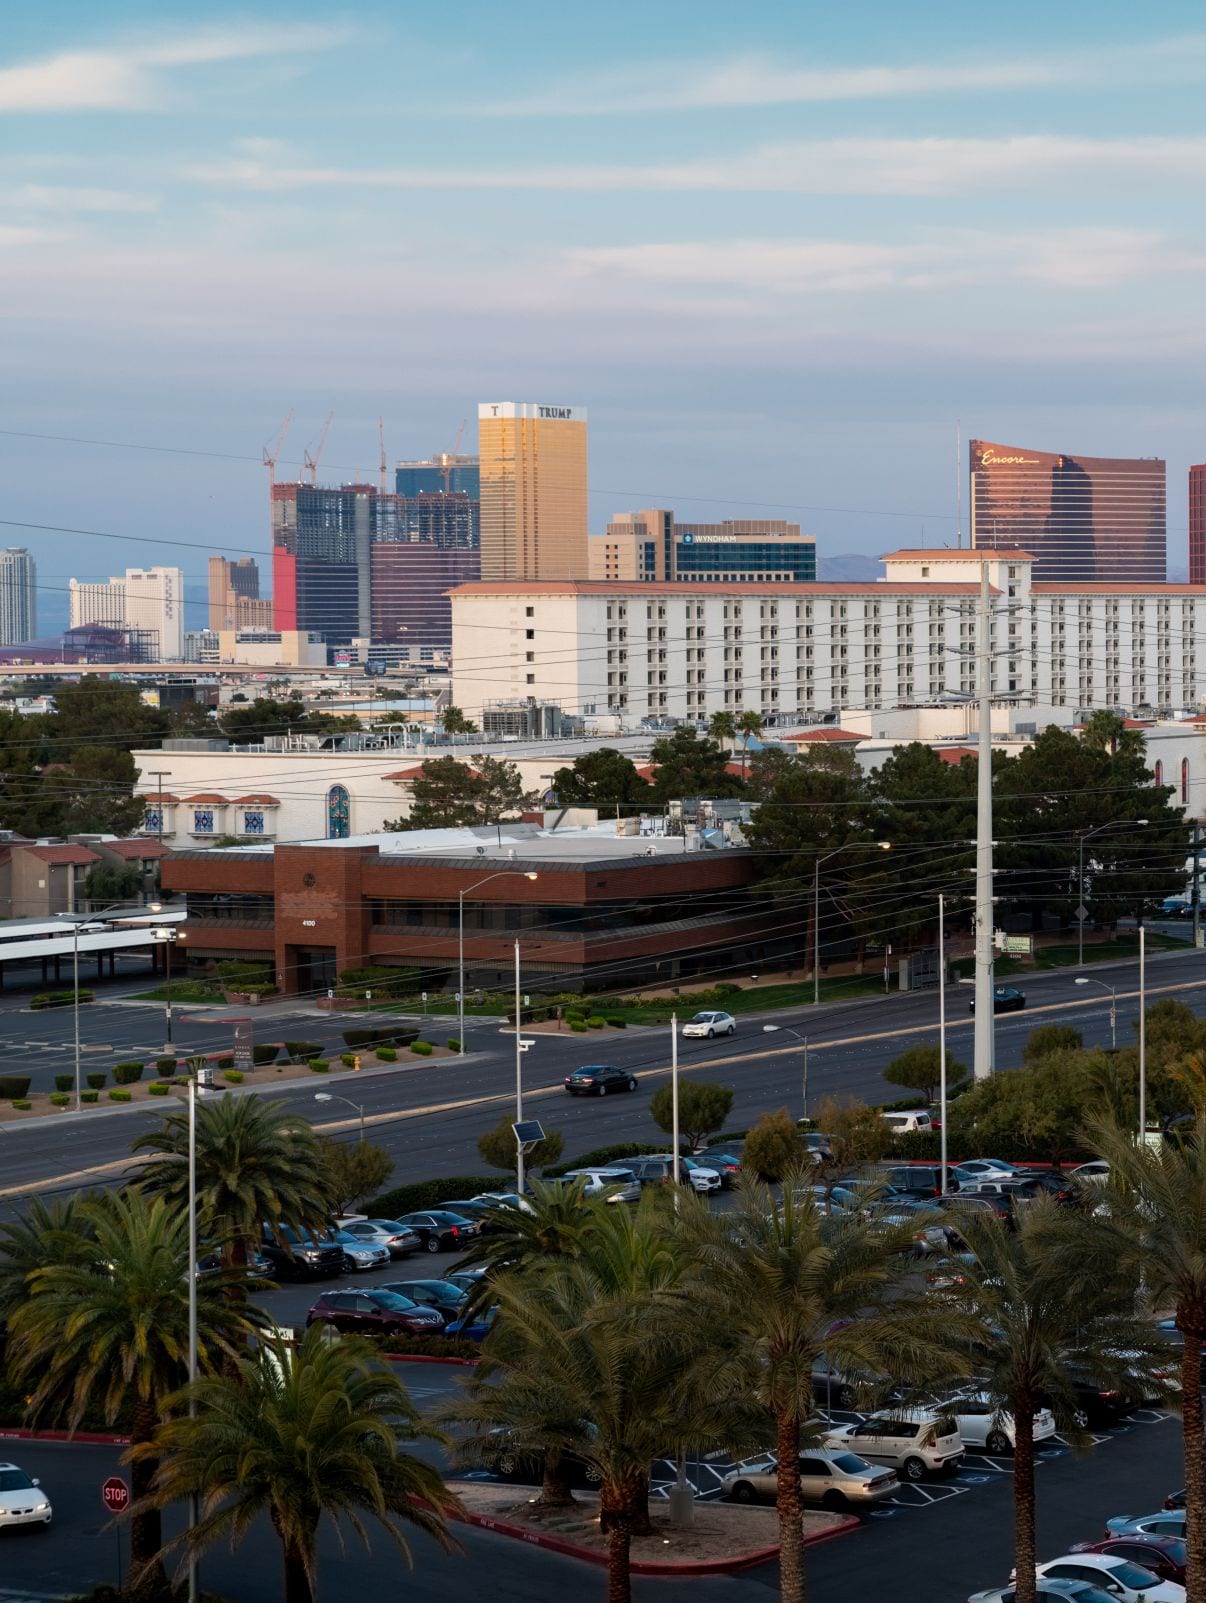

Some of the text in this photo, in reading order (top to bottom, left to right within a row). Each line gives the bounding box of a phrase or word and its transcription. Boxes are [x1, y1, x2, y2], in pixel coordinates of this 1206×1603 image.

[491, 406, 499, 417] T
[539, 407, 572, 419] TRUMP
[981, 449, 1040, 465] Encore
[695, 535, 737, 543] WYNDHAM
[105, 1487, 127, 1501] STOP
